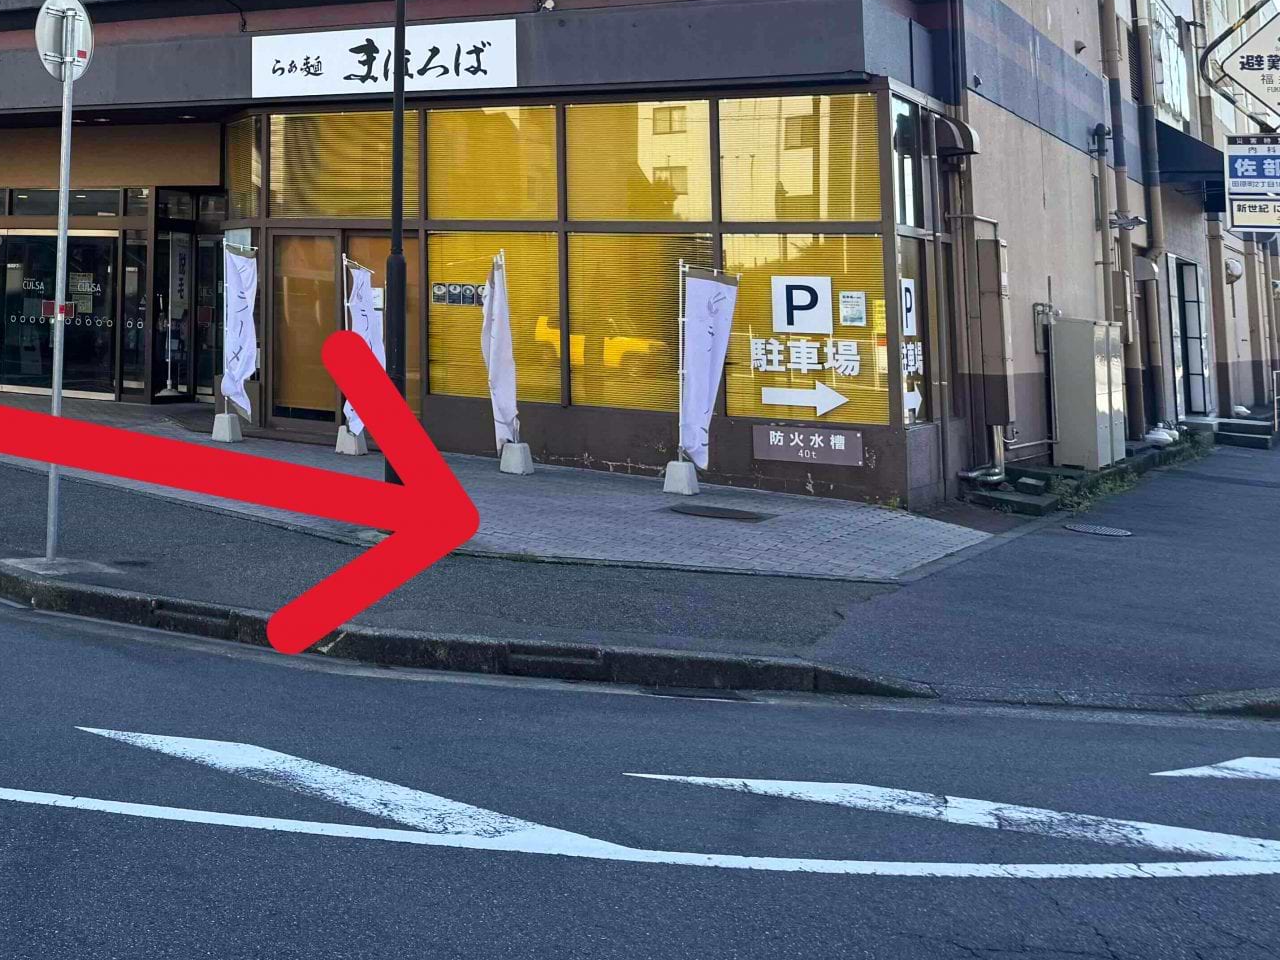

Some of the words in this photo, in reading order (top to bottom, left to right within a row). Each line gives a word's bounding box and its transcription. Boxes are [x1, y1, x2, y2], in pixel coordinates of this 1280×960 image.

[1261, 73, 1280, 85] 福
[23, 280, 45, 290] CULSA
[785, 284, 819, 326] P
[904, 286, 913, 329] P
[751, 338, 861, 376] 駐車場
[769, 430, 845, 450] 防火水槽
[798, 449, 817, 459] 40t
